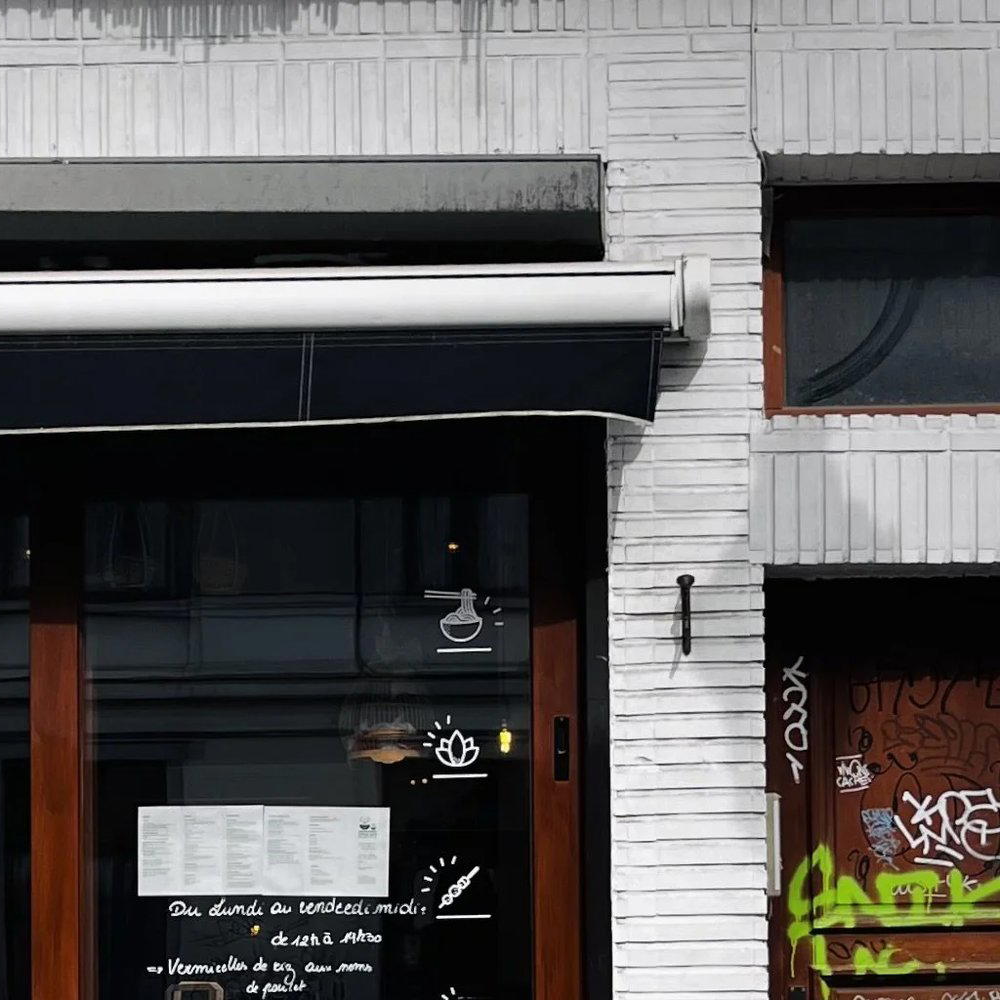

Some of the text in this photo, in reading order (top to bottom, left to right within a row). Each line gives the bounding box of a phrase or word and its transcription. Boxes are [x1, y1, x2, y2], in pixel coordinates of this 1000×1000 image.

[168, 900, 202, 916] Du
[270, 901, 292, 915] au
[270, 931, 289, 946] de
[253, 957, 268, 972] de
[246, 980, 259, 993] de
